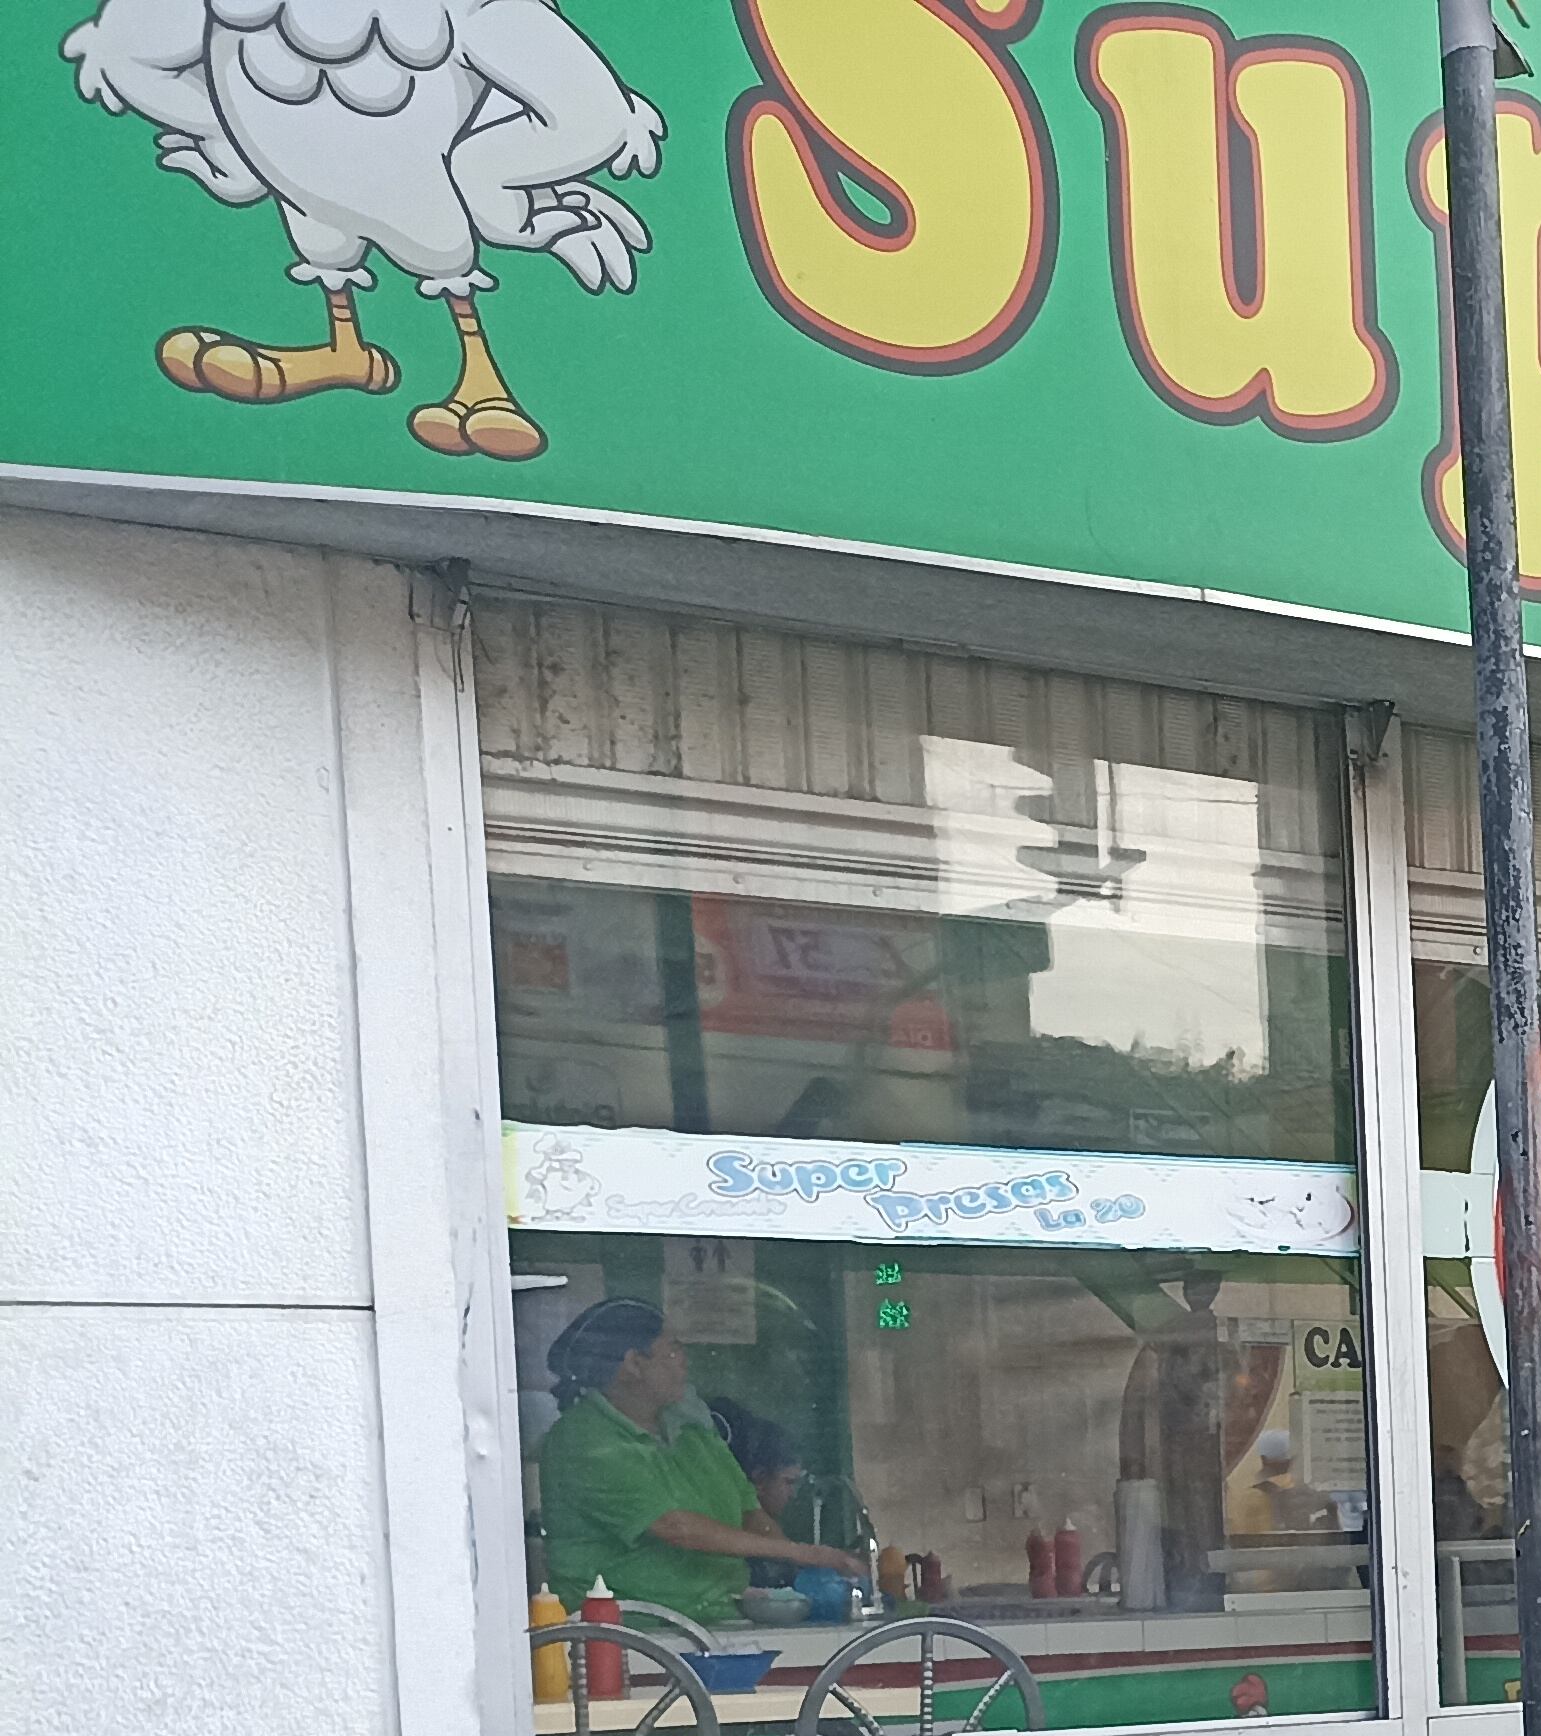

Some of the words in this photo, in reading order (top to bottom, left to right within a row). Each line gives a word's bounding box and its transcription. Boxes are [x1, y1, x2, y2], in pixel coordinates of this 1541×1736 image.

[707, 1149, 906, 1202] Super
[1037, 1208, 1087, 1231] La
[1090, 1193, 1147, 1224] 20
